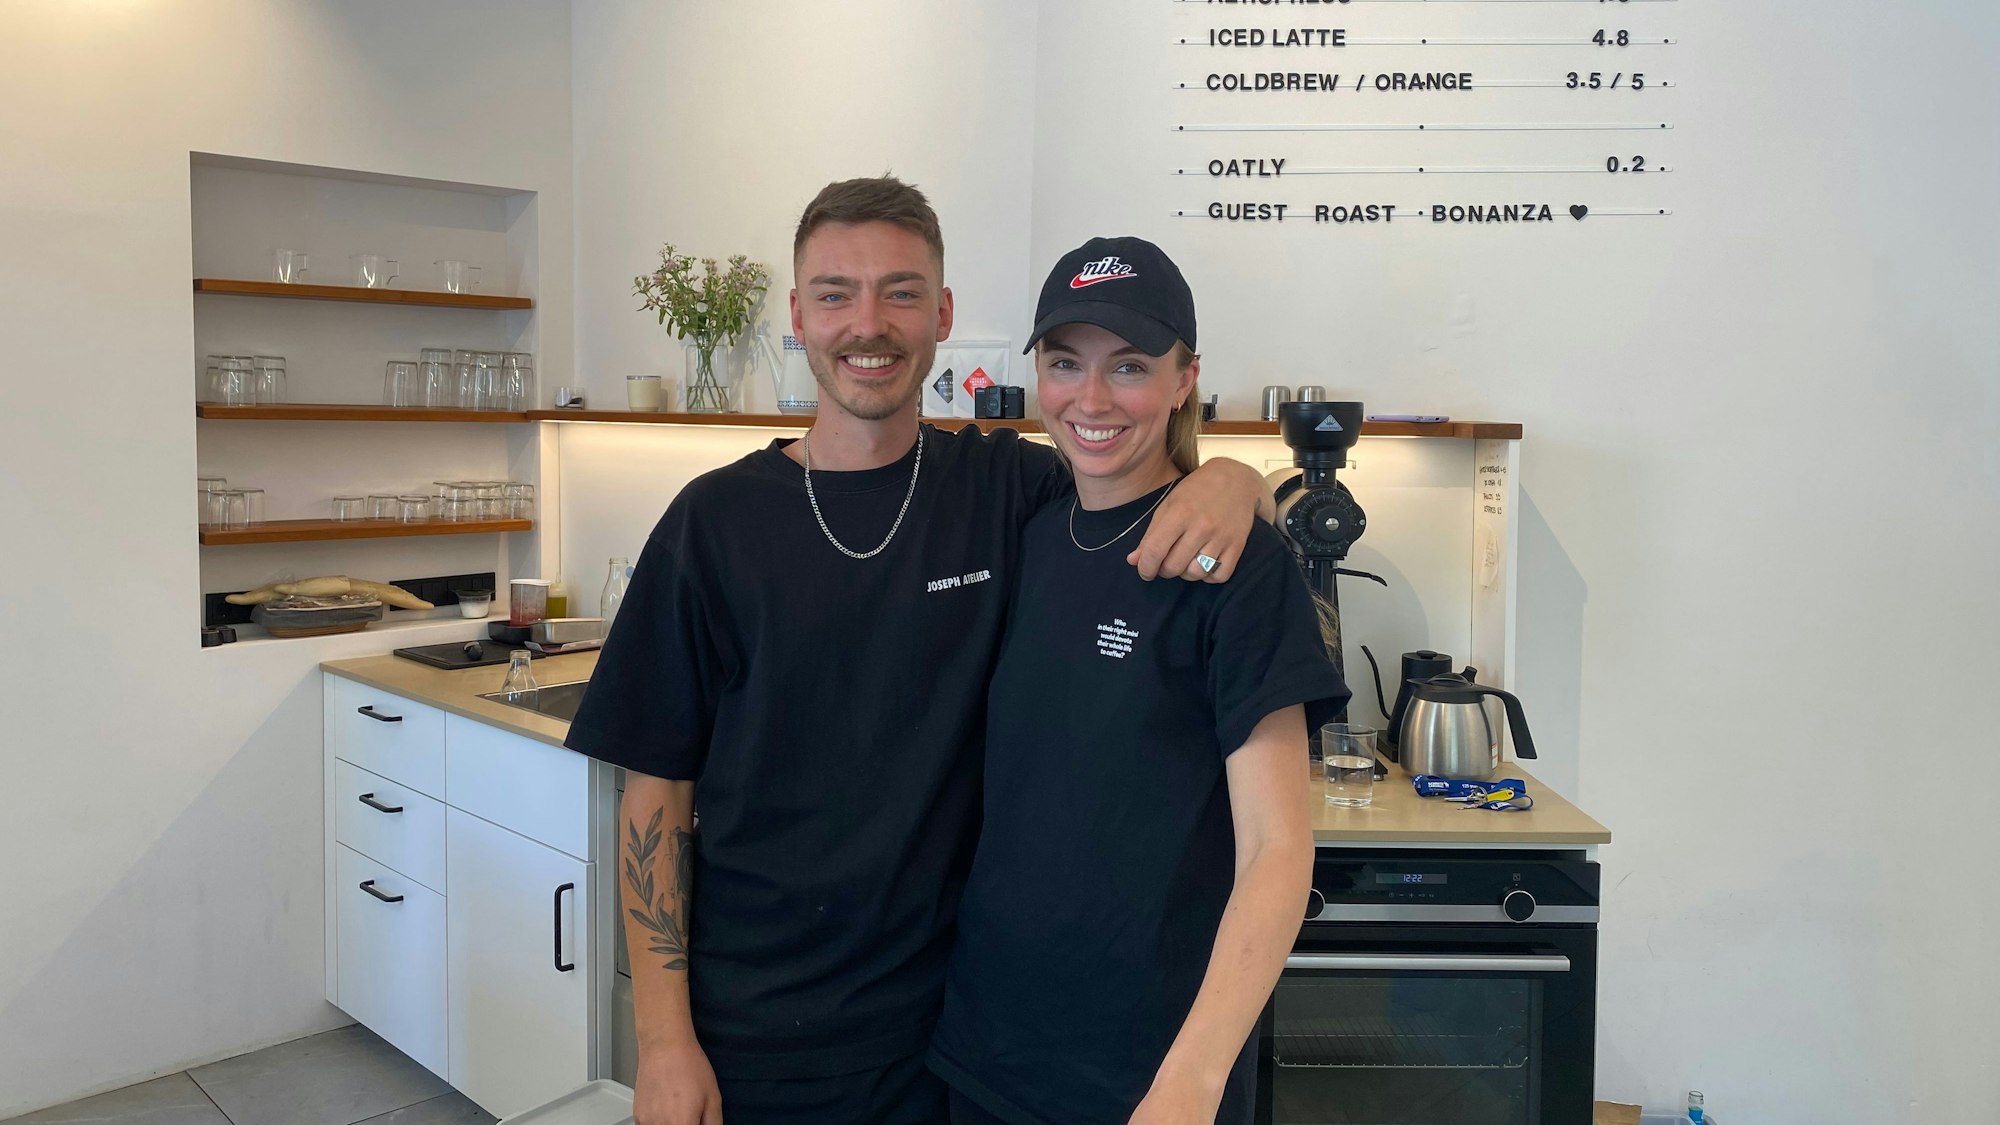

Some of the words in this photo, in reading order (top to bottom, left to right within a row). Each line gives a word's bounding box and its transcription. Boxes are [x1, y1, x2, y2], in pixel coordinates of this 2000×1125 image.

[1210, 28, 1266, 46] ICED
[1272, 28, 1346, 47] LATTE
[1592, 29, 1629, 47] 4.8
[1206, 72, 1339, 91] COLDBREW
[1355, 74, 1365, 91] /
[1375, 72, 1472, 91] ORANGE
[1566, 71, 1601, 90] 3.5
[1631, 73, 1644, 91] 5
[1208, 158, 1285, 177] OATLY
[1606, 155, 1645, 173] 0.2
[1208, 202, 1288, 221] GUEST
[1315, 204, 1396, 223] ROAST
[1432, 204, 1553, 222] BONANZA
[1083, 256, 1132, 276] nike
[927, 576, 961, 592] JOSEPH
[963, 569, 991, 585] ATELIER
[1114, 618, 1126, 627] Who
[1114, 627, 1127, 635] right
[1100, 633, 1115, 641] would
[1115, 635, 1132, 644] devote
[1109, 642, 1123, 650] whole
[1106, 650, 1125, 658] coffee?
